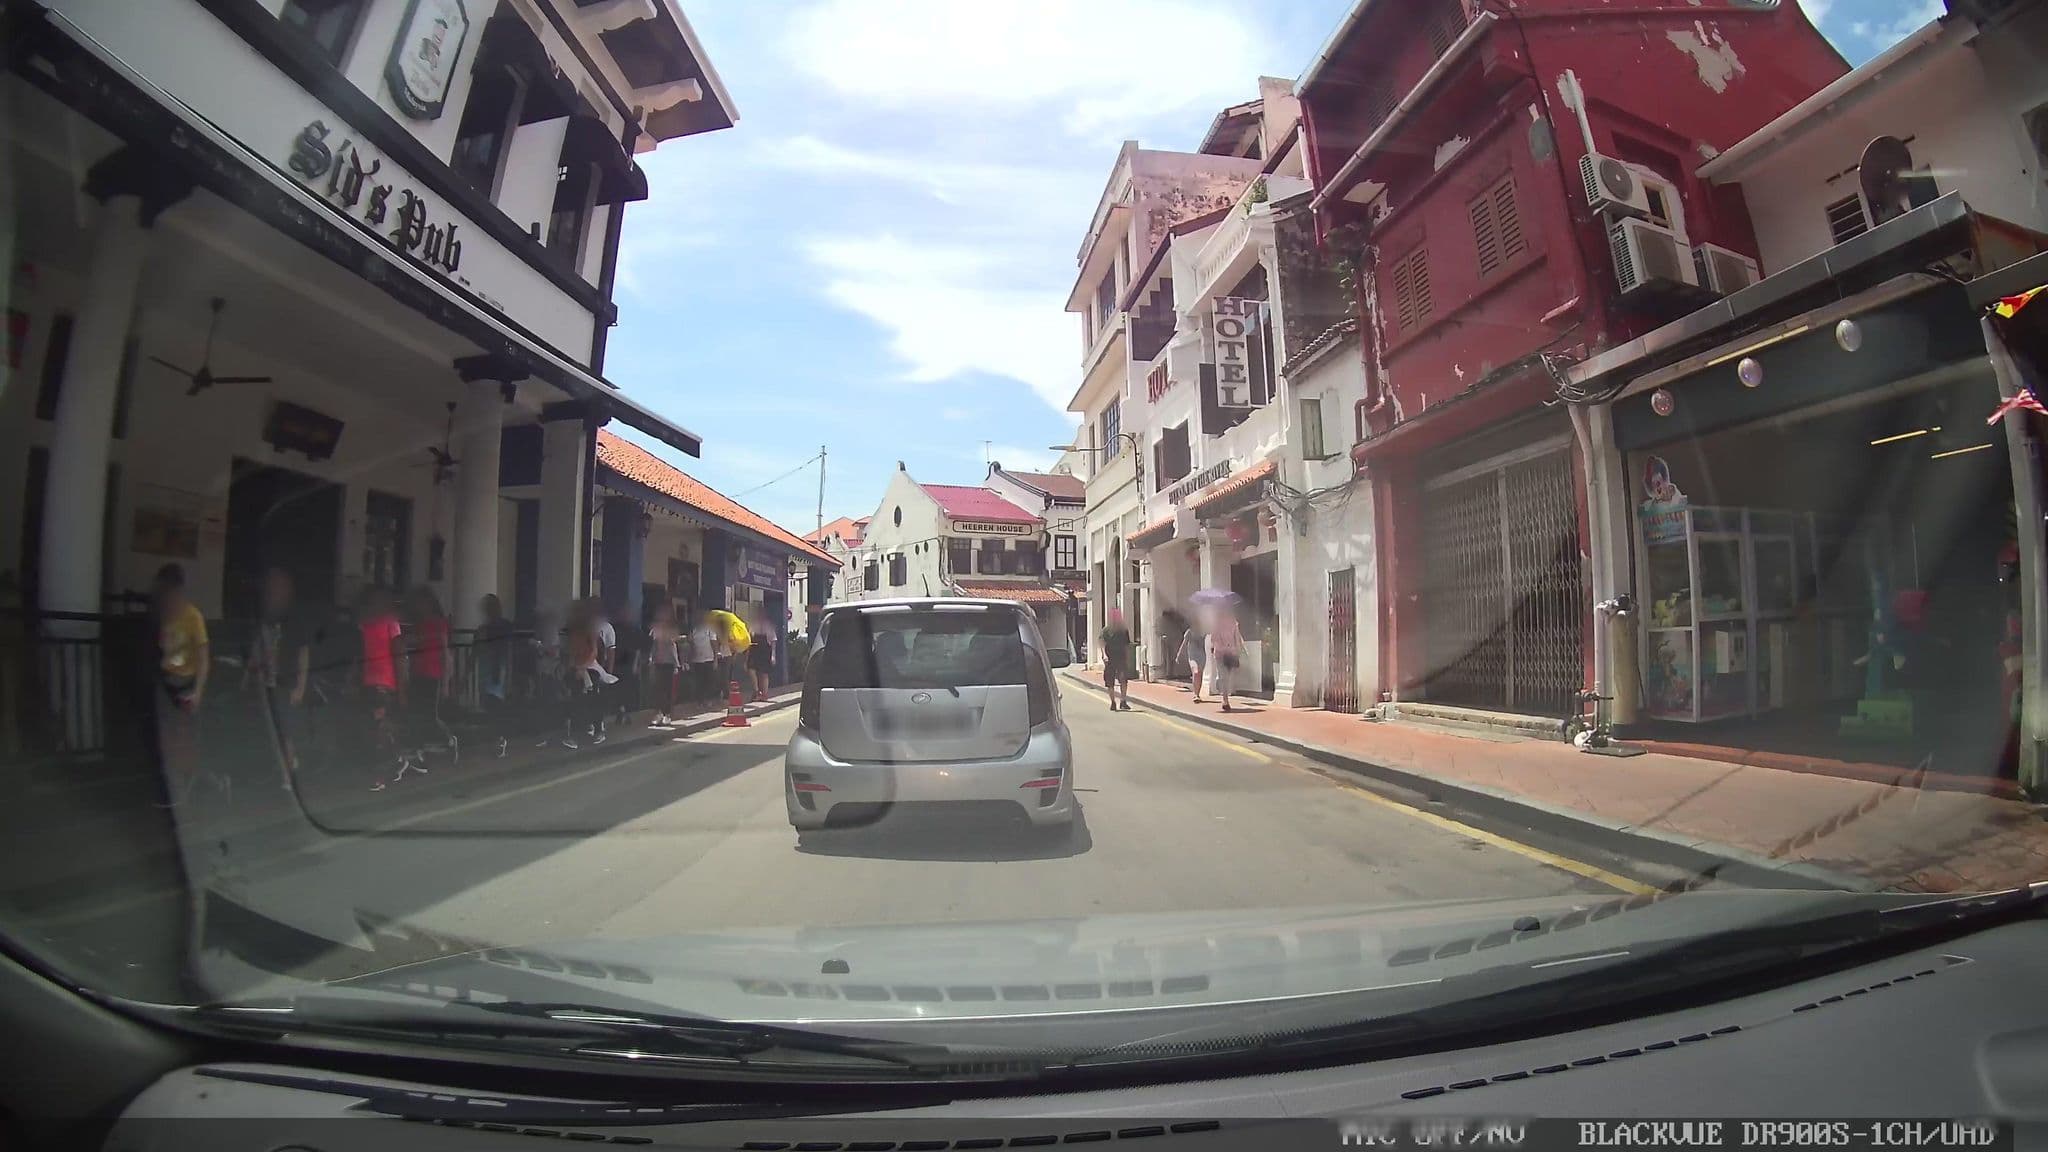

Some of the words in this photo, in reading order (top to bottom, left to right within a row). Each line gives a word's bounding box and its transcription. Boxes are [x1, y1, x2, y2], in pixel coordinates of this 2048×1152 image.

[288, 119, 392, 224] Sid's
[389, 188, 462, 274] Pub
[1213, 296, 1249, 407] HOTEL
[962, 522, 994, 532] HEEREN
[997, 524, 1024, 533] HOUSE
